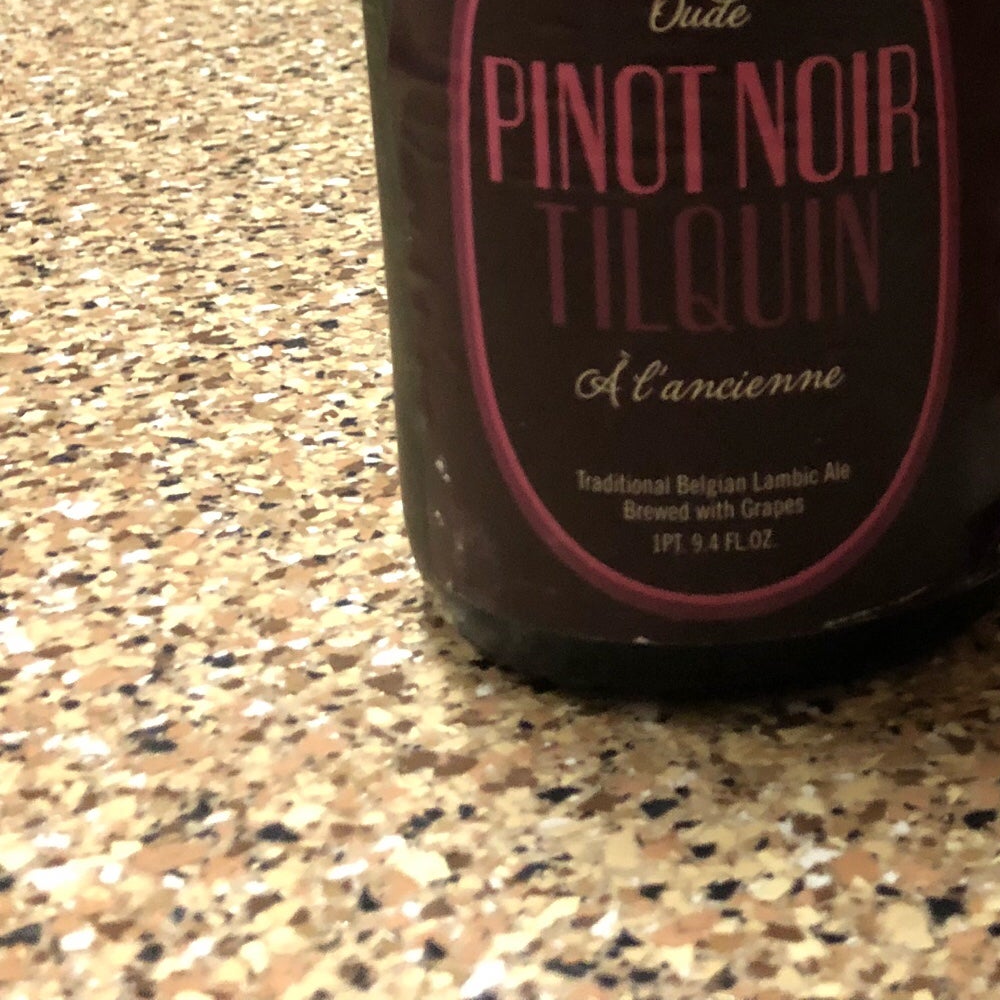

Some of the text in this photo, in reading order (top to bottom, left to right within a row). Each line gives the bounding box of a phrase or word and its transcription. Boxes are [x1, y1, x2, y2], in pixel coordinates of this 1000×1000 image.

[482, 43, 921, 195] PINOT NOIR
[537, 189, 881, 333] TILQUIN
[632, 359, 845, 402] l'ancienne
[576, 461, 851, 498] Traditional Belgian Lambic Ale
[623, 496, 804, 521] Brewed with Grapes
